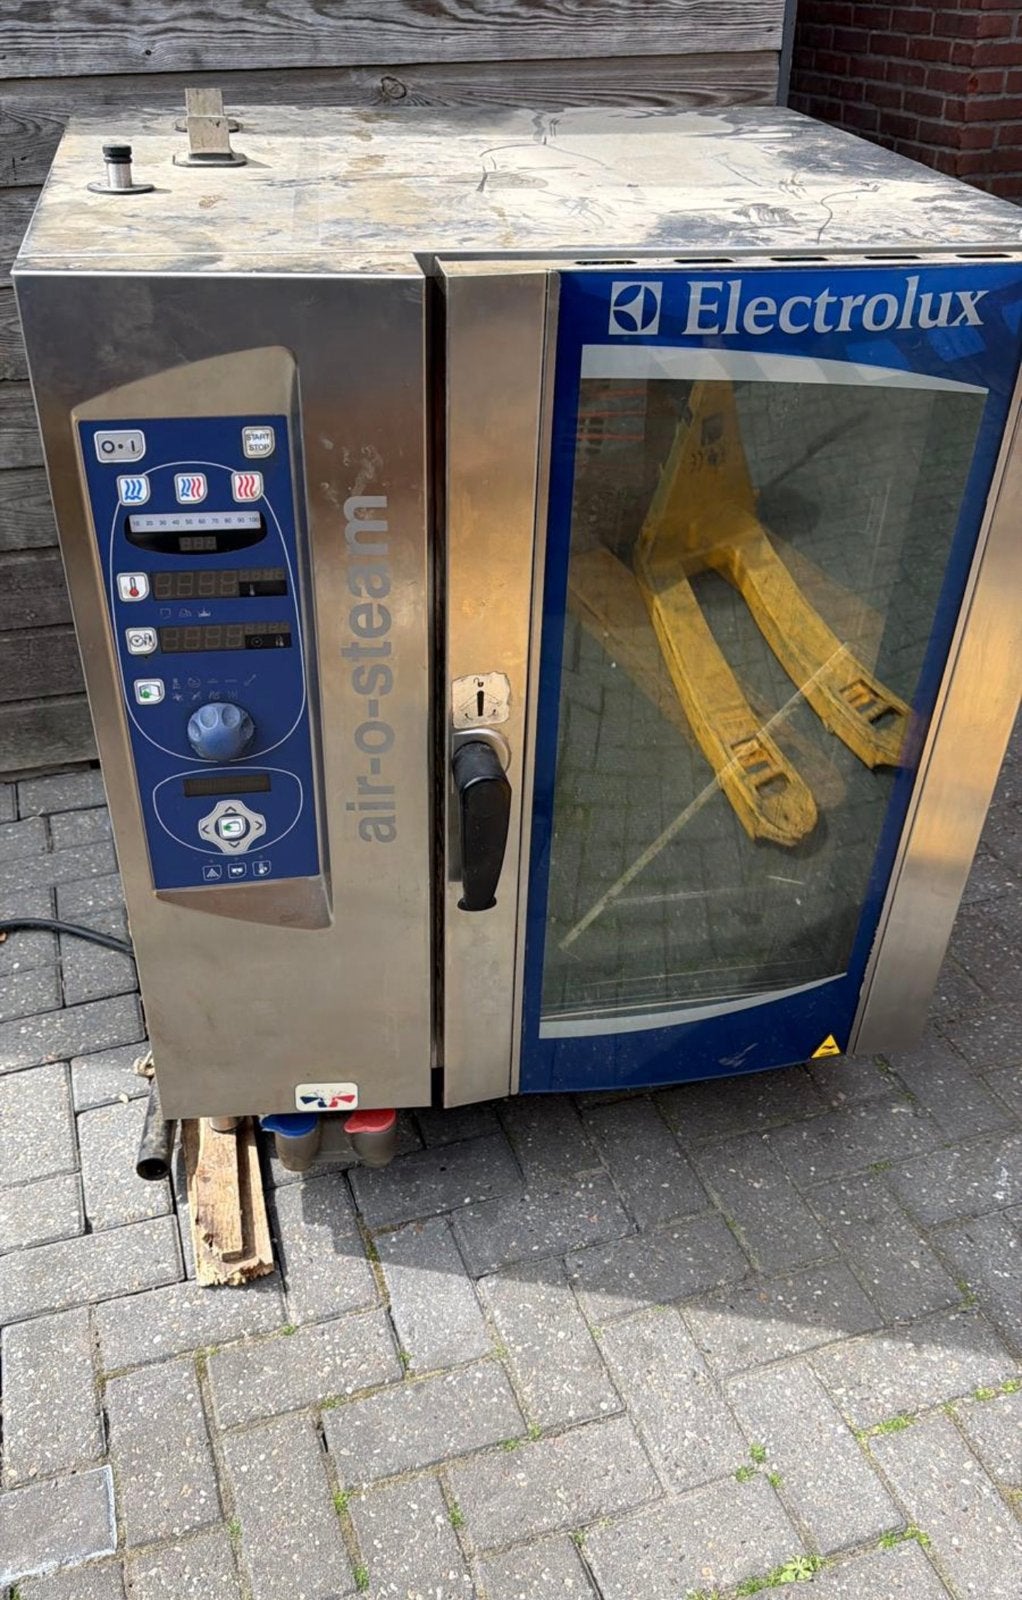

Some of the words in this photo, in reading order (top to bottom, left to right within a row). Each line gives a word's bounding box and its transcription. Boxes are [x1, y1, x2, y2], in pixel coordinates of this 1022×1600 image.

[682, 275, 990, 336] Electrolux
[245, 433, 269, 441] START
[342, 495, 397, 843] air-o-steam
